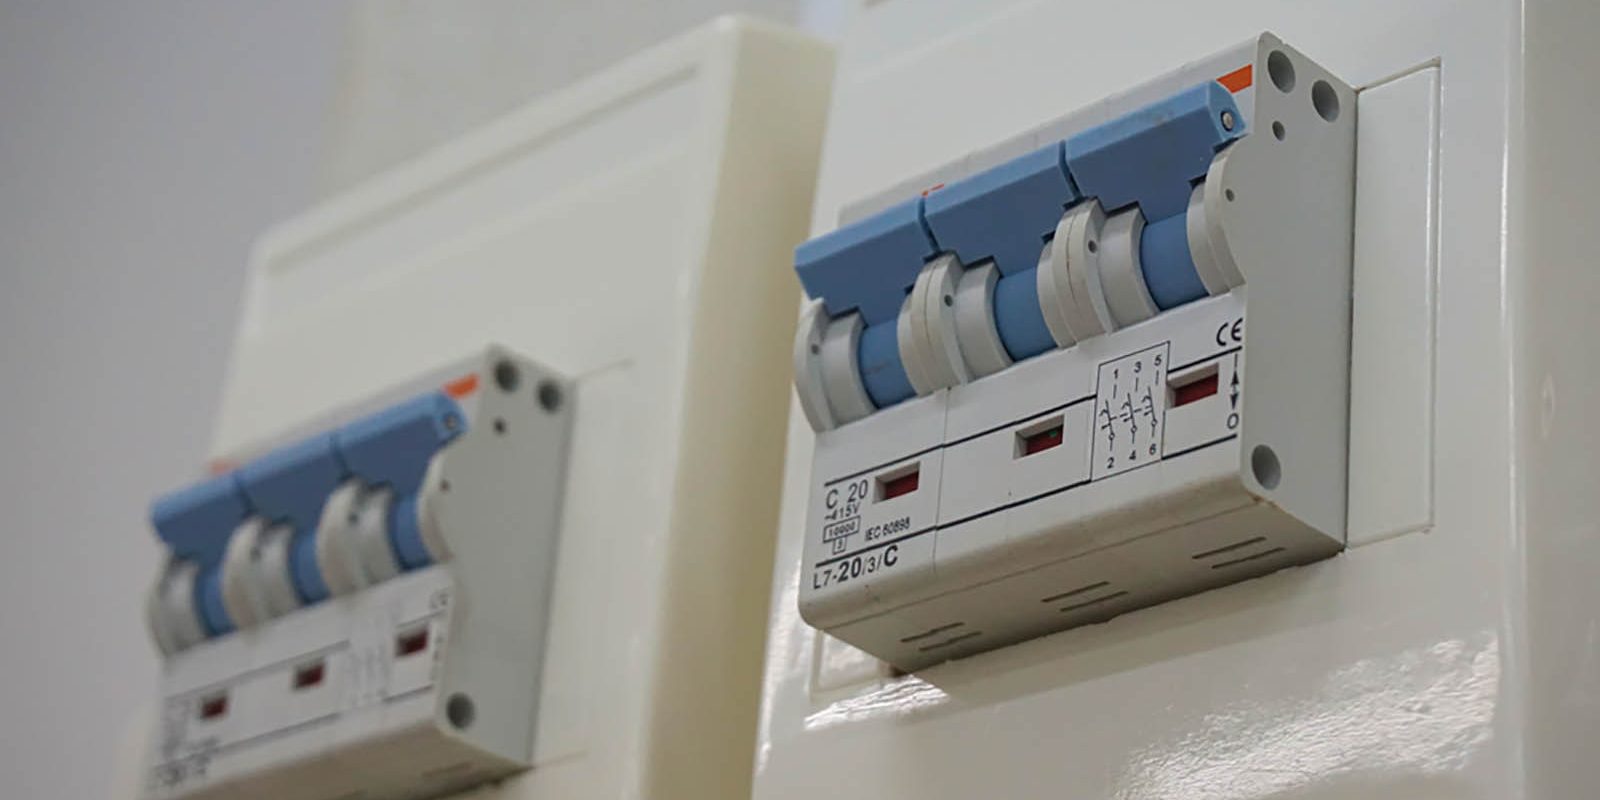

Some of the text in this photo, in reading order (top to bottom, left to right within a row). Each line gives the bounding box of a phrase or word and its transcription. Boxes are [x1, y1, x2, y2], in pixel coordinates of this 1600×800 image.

[1216, 317, 1243, 346] CE
[1113, 354, 1162, 379] 1 3 5
[1107, 443, 1157, 469] 2 4 6
[825, 479, 869, 509] C 20
[865, 526, 881, 541] IEC
